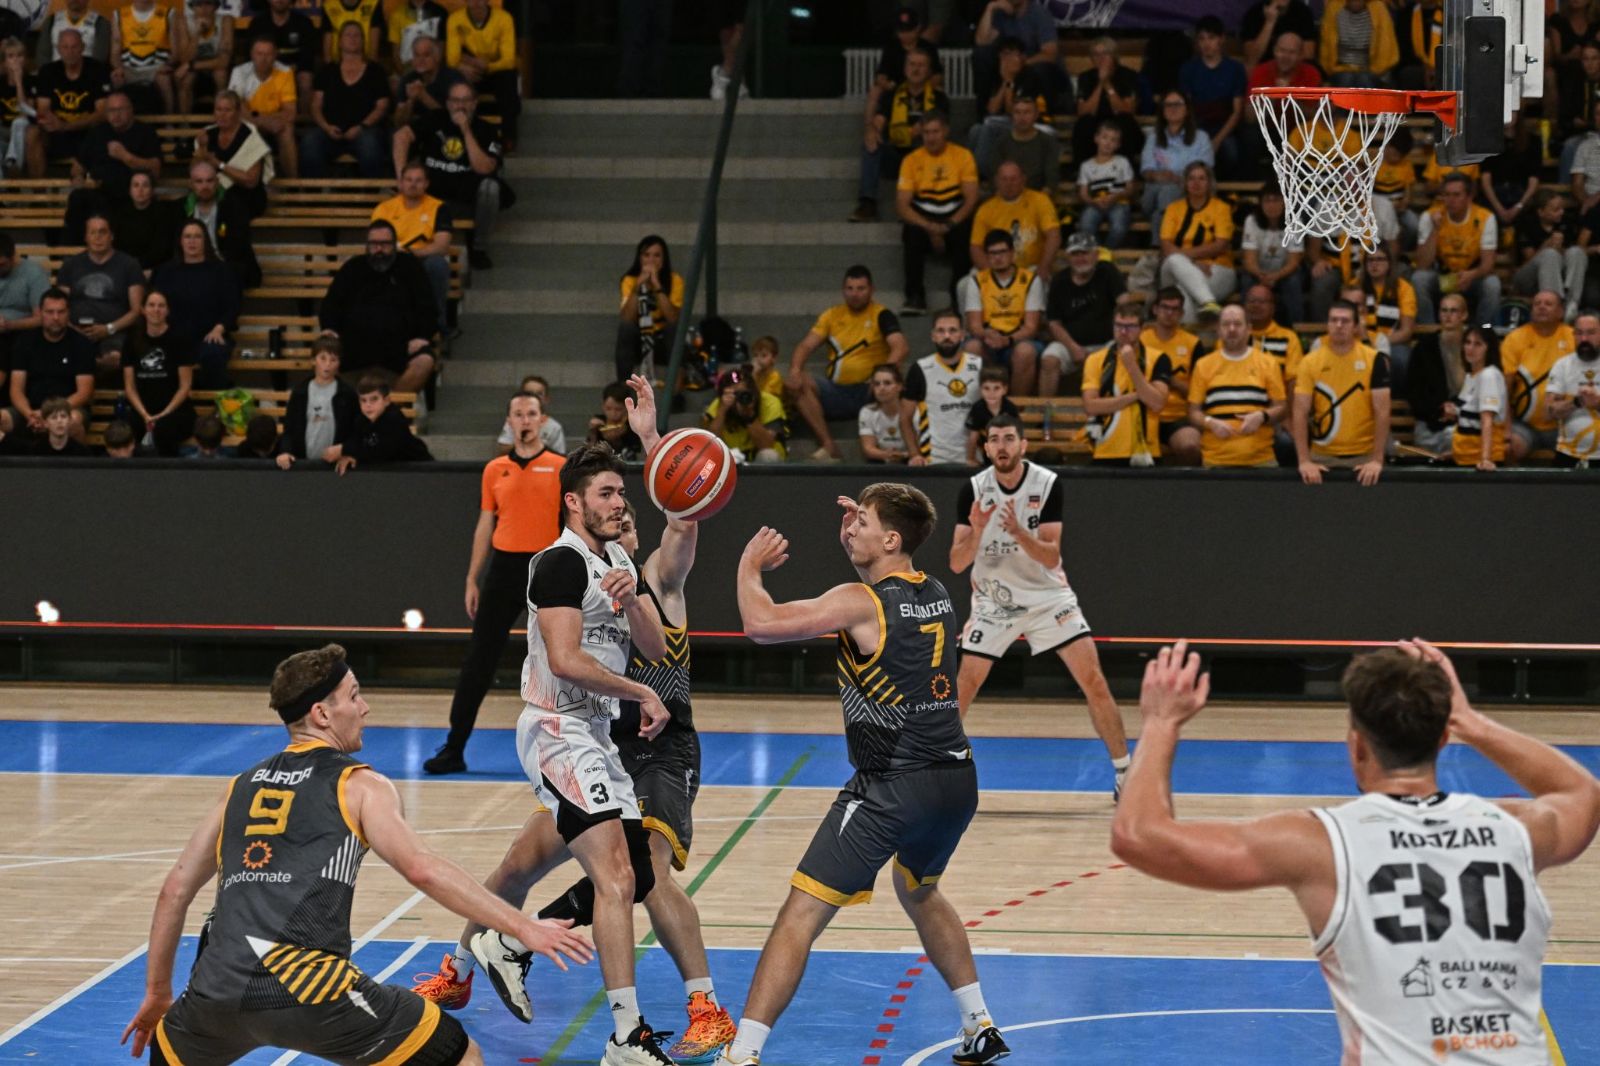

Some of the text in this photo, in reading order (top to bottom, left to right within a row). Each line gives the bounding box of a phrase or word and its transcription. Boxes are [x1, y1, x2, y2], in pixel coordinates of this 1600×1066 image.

[664, 444, 694, 480] molten
[1027, 515, 1039, 530] 8
[919, 621, 945, 668] 7
[969, 630, 983, 644] 8
[915, 700, 960, 713] photoma
[251, 767, 313, 786] BURDA
[590, 782, 610, 805] 3
[245, 788, 296, 836] 9
[223, 870, 292, 890] photomate
[1367, 861, 1526, 945] 30
[1440, 961, 1475, 973] BALI
[1431, 1013, 1511, 1035] BASKET
